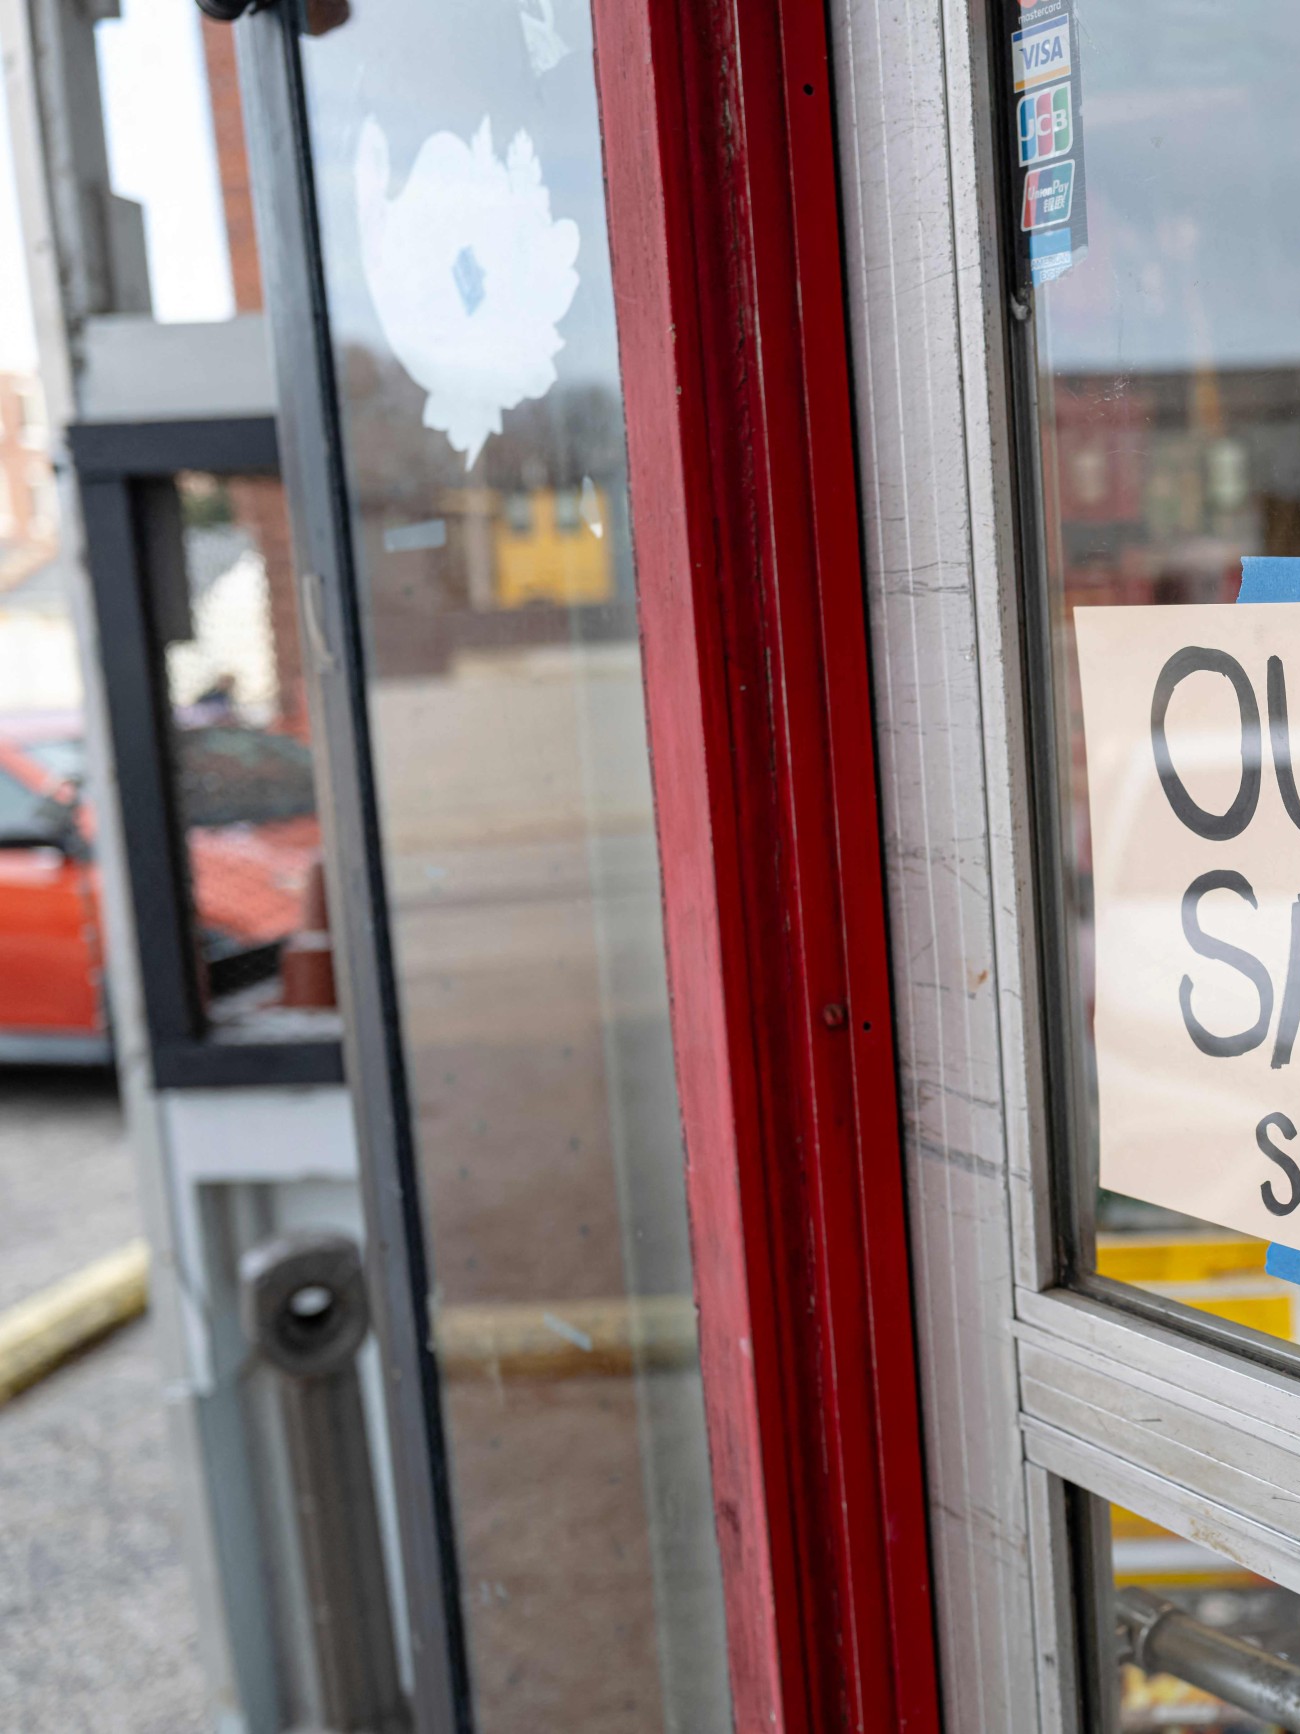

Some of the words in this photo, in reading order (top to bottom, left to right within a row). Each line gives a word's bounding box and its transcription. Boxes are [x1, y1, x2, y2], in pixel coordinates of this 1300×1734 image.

[1018, 0, 1061, 24] mastercard
[1019, 36, 1063, 70] VISA
[1021, 108, 1067, 141] JCB
[1028, 179, 1069, 201] UnionPay
